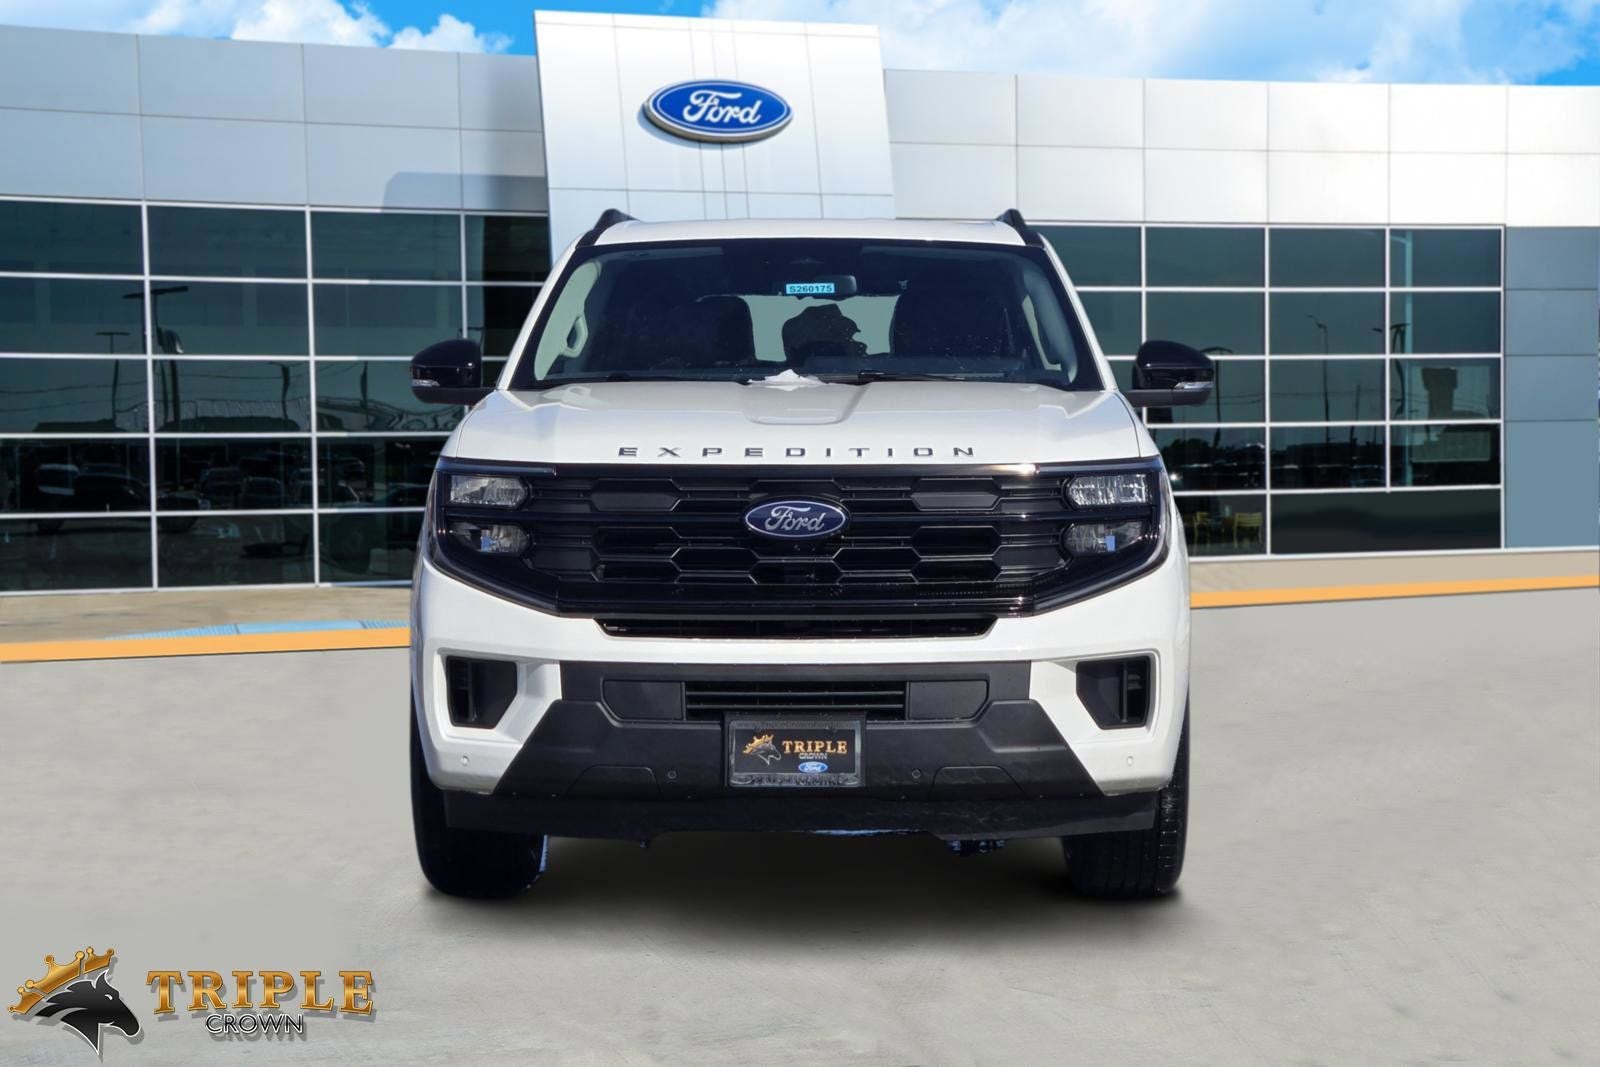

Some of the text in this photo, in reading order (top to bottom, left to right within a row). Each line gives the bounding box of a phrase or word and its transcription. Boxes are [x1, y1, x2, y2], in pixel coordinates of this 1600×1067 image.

[683, 90, 763, 124] Ford
[789, 285, 833, 293] S260175
[618, 447, 975, 457] EXPEDITION
[765, 505, 826, 531] Ford
[782, 740, 848, 754] TRIPLE
[799, 752, 828, 760] CROWN
[803, 763, 823, 772] Ford
